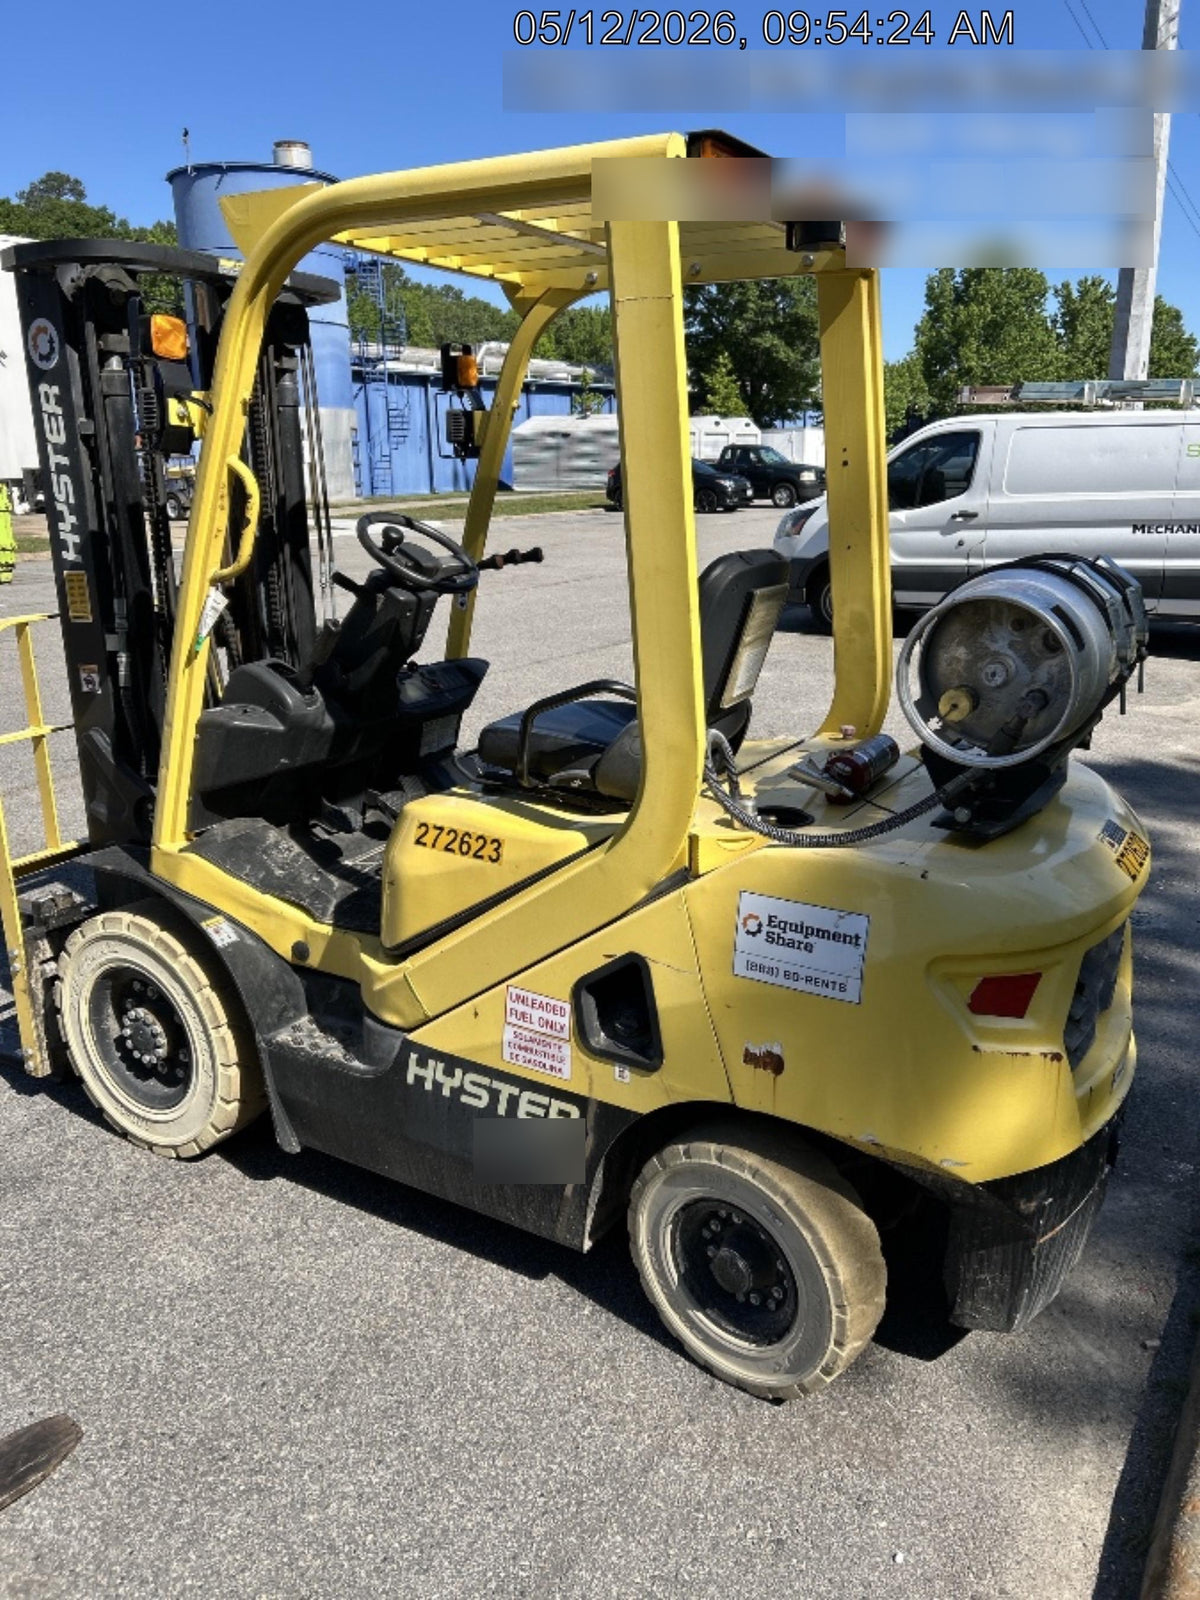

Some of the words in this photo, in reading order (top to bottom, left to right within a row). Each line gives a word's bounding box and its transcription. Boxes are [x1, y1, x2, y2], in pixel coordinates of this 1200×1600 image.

[39, 383, 82, 562] HYSTER
[414, 822, 503, 863] 272623
[765, 931, 814, 954] Share
[766, 913, 862, 948] Equipment
[745, 959, 780, 979] (888)
[509, 991, 566, 1020] UNLEADED
[509, 1007, 535, 1025] FUEL
[537, 1017, 566, 1035] ONLY
